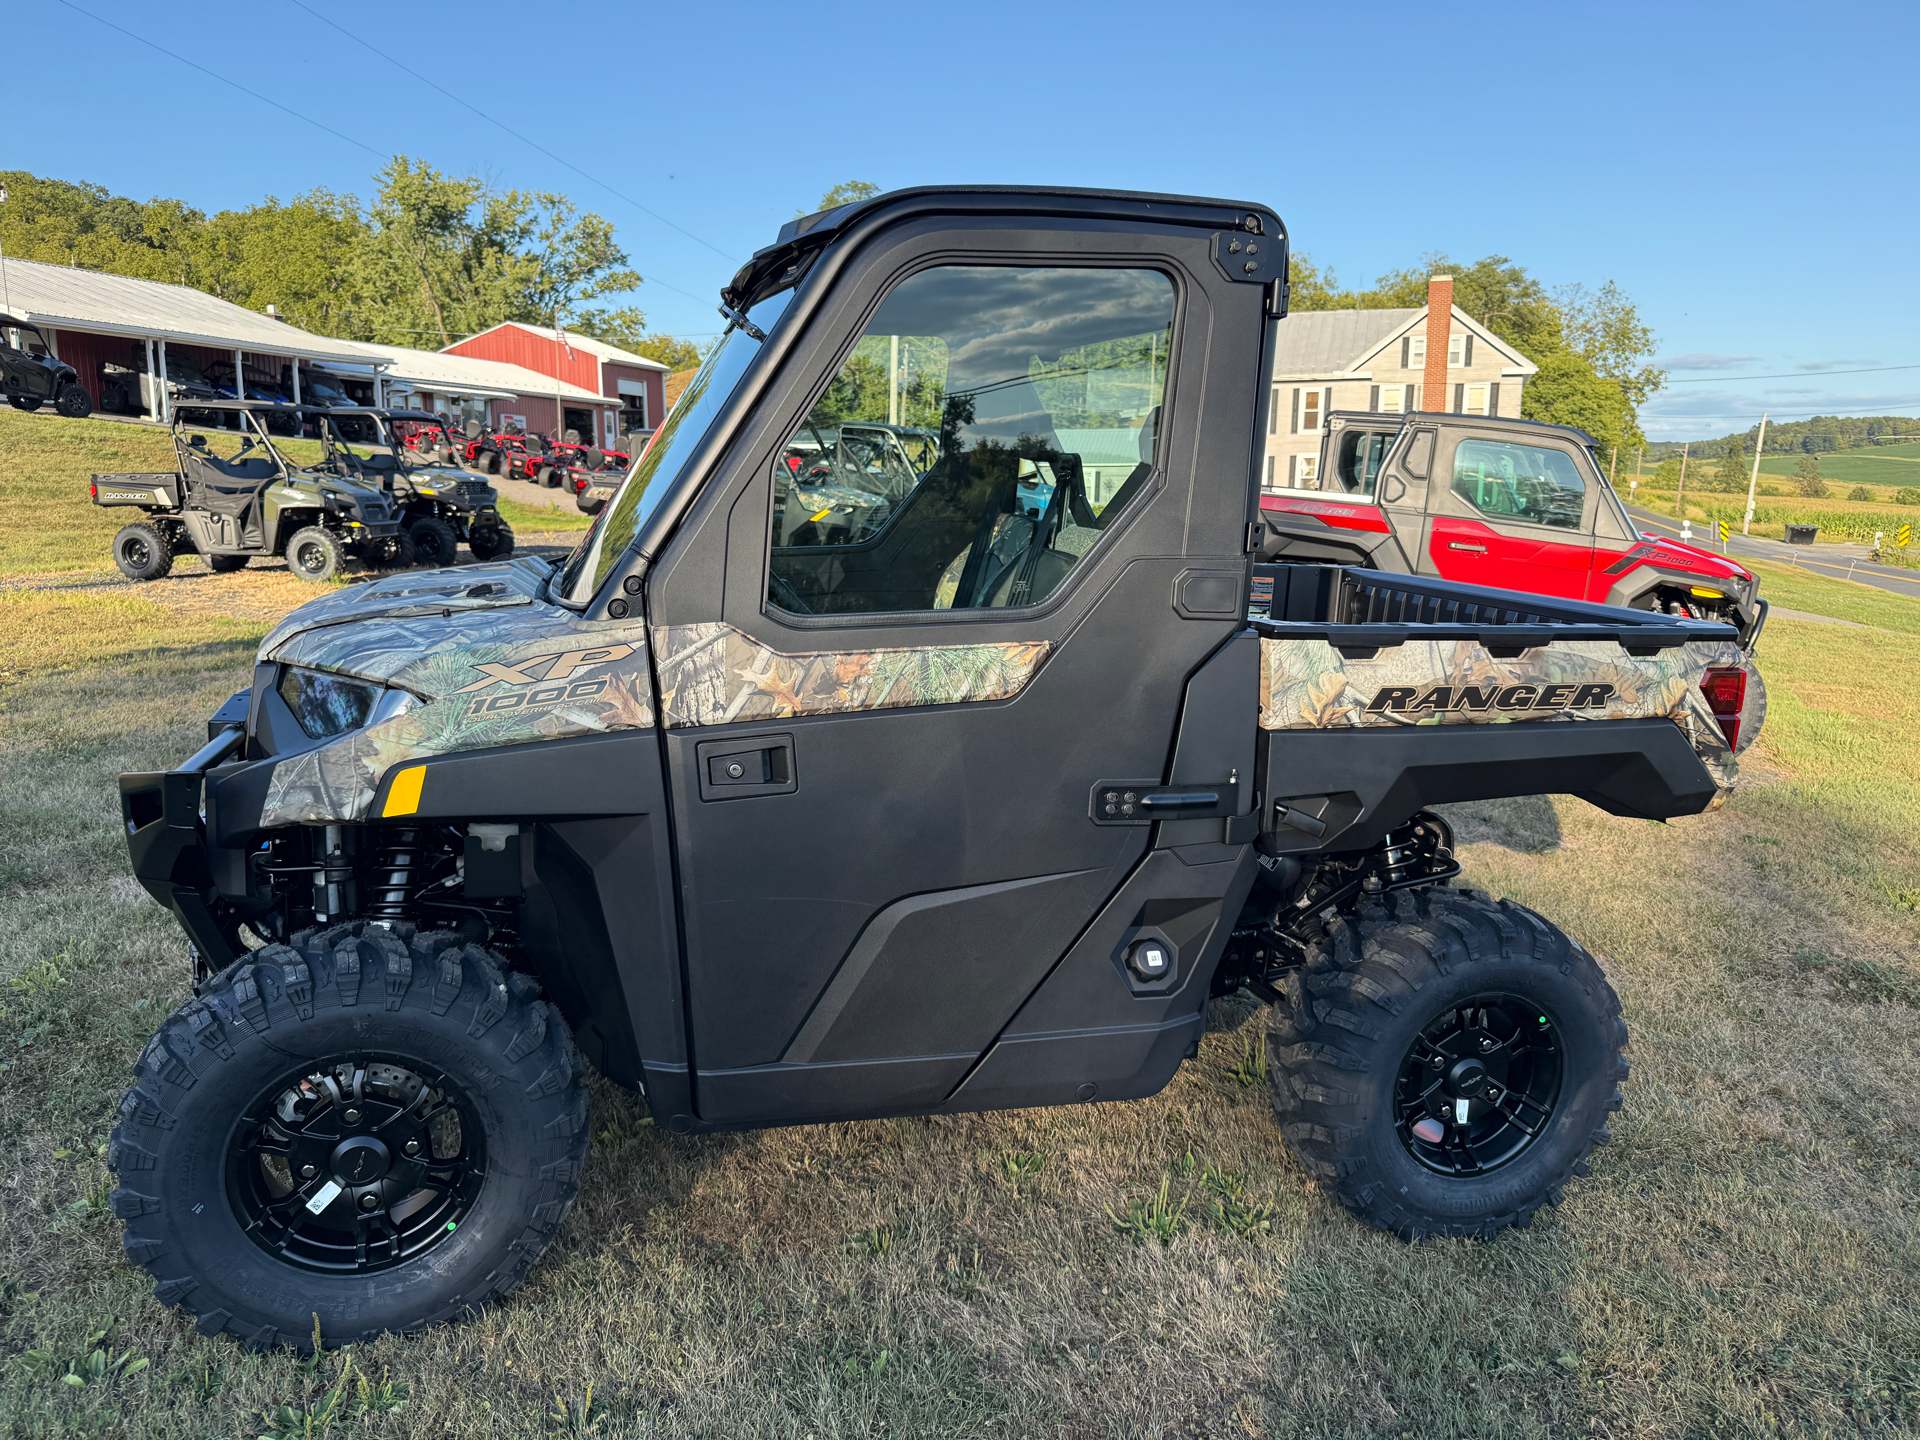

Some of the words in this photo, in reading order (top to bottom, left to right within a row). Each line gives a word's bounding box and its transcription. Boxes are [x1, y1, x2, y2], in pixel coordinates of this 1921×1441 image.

[1639, 548, 1669, 560] XP
[1666, 557, 1694, 566] 1000
[452, 643, 635, 695] XP
[468, 679, 611, 717] 1000
[504, 701, 573, 719] OVERHEAD
[1363, 682, 1617, 713] RANGER
